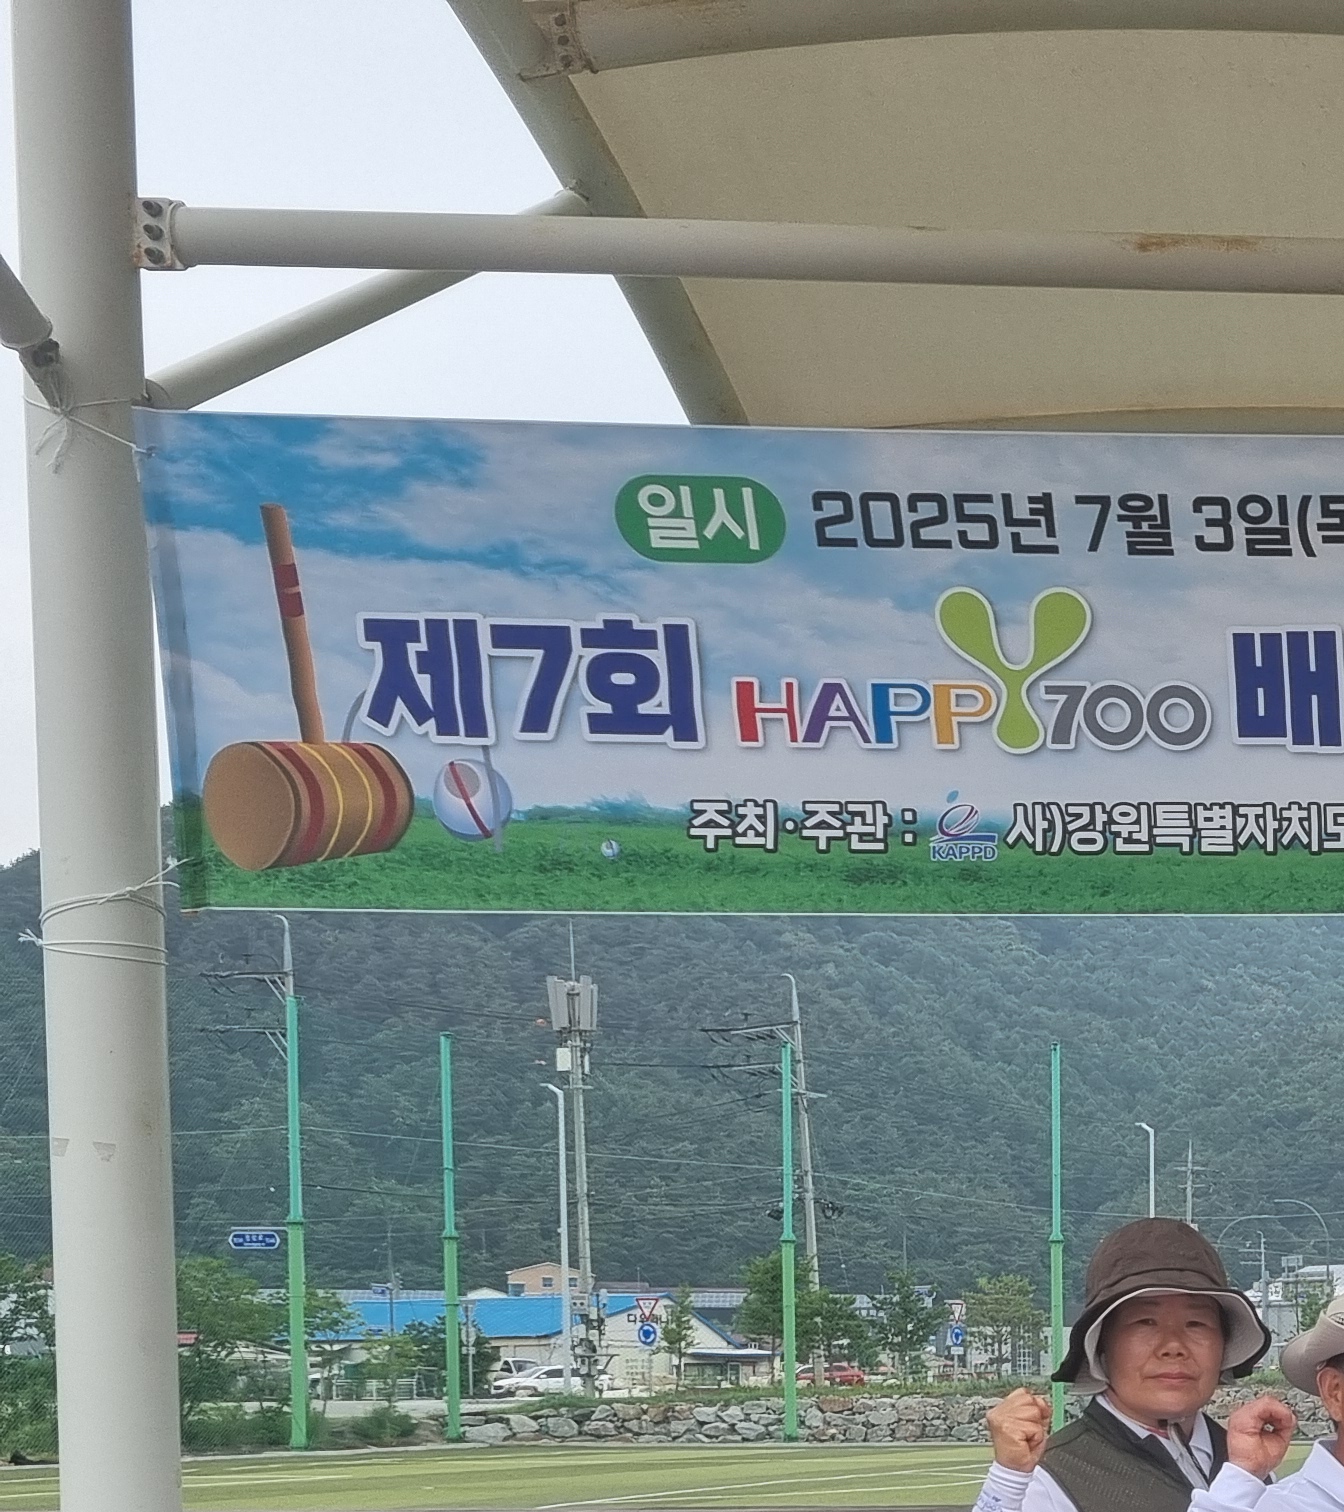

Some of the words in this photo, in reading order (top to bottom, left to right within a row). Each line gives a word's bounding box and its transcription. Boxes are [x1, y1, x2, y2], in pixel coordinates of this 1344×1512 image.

[637, 483, 760, 551] 일시
[812, 491, 1059, 555] 2025년
[1075, 494, 1175, 556] 7월
[358, 612, 706, 748] 제7회
[930, 843, 998, 861] KAPPD
